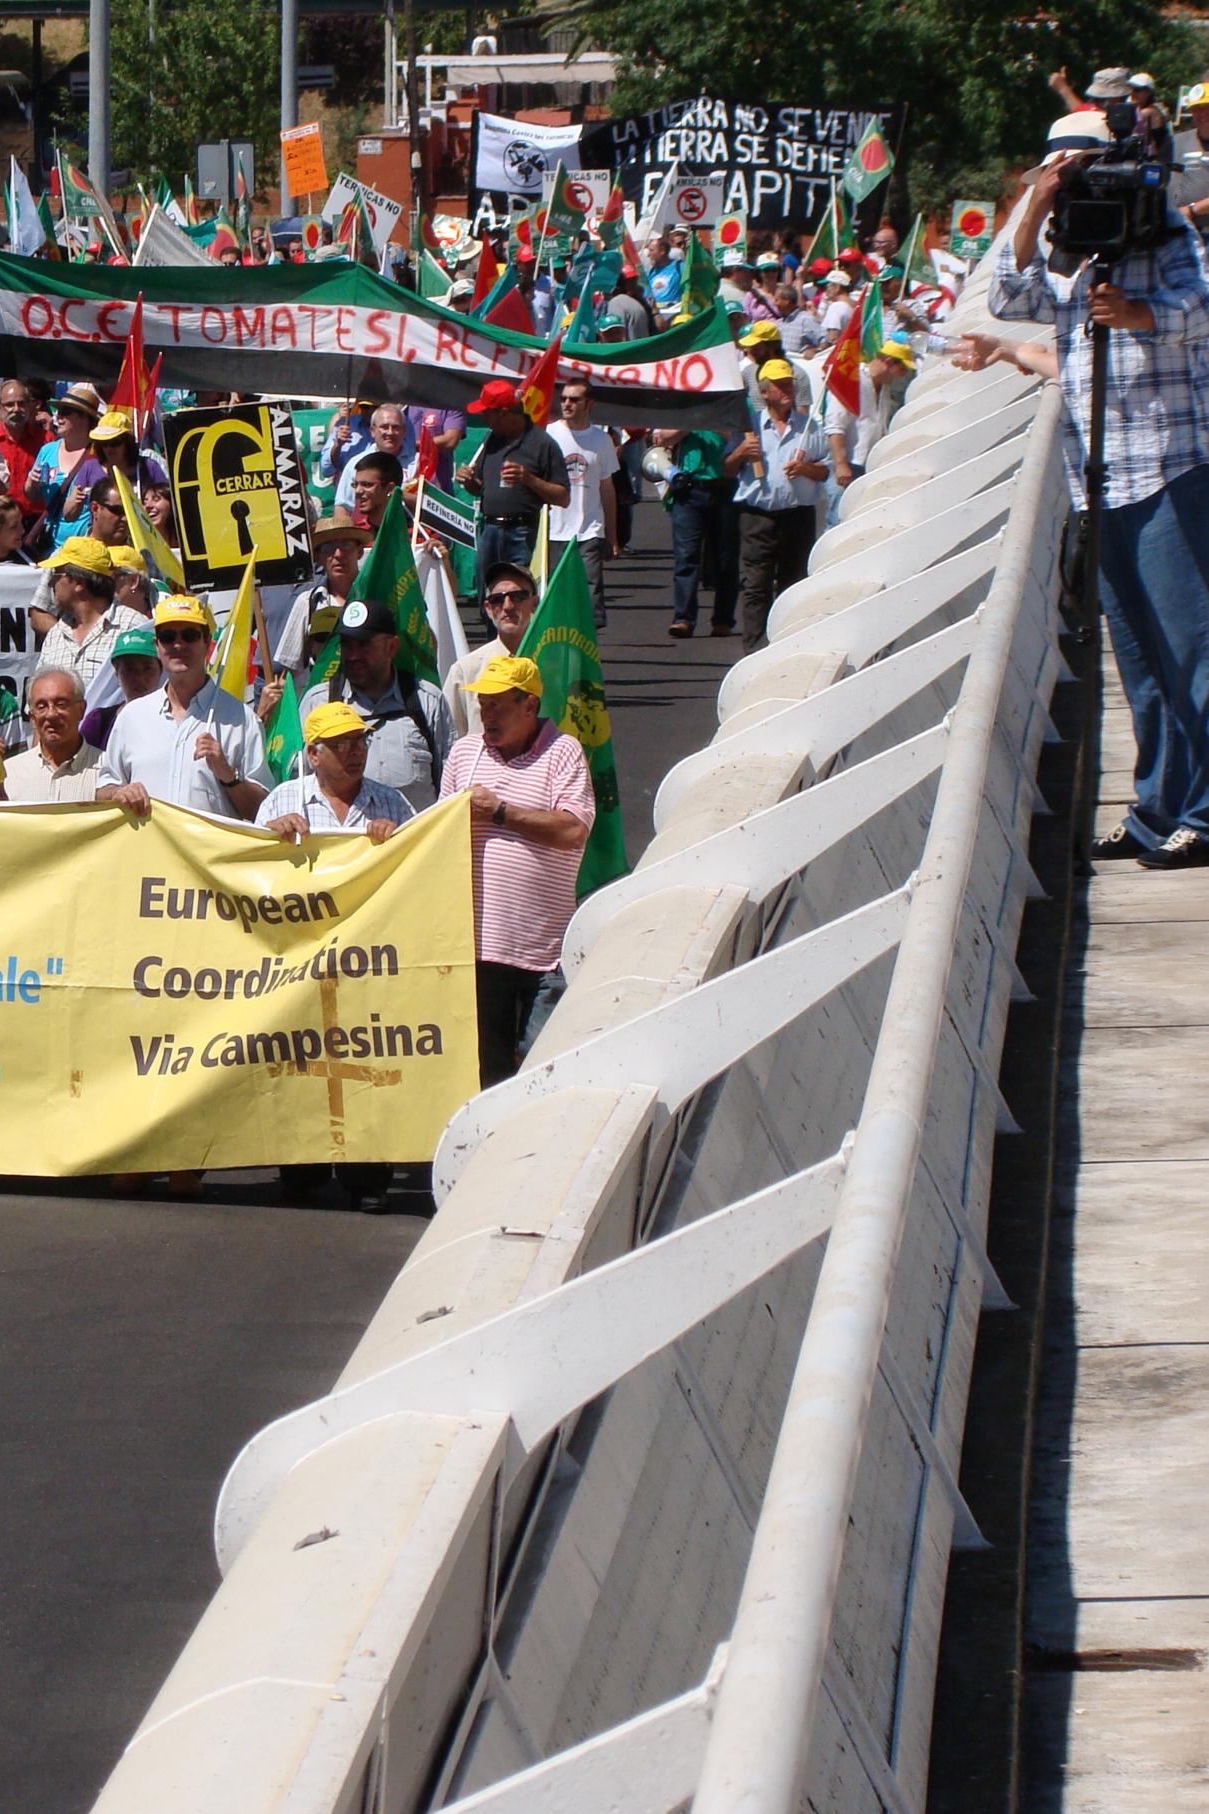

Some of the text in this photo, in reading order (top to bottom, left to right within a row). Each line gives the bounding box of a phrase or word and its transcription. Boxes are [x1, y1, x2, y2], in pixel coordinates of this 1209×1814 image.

[612, 120, 638, 143] LA
[644, 96, 728, 131] TIERRA
[735, 103, 769, 134] NO
[644, 129, 728, 162] TIERRA
[735, 134, 770, 163] SE
[544, 172, 608, 182] TEICAS NO
[385, 201, 401, 216] NO
[654, 352, 714, 393] NO
[216, 472, 275, 493] CERRAR
[269, 404, 309, 557] ALMARAZ
[463, 521, 475, 534] NO
[139, 876, 341, 934] European
[133, 935, 399, 1000] Coordination
[130, 1012, 444, 1077] Via Campesina
